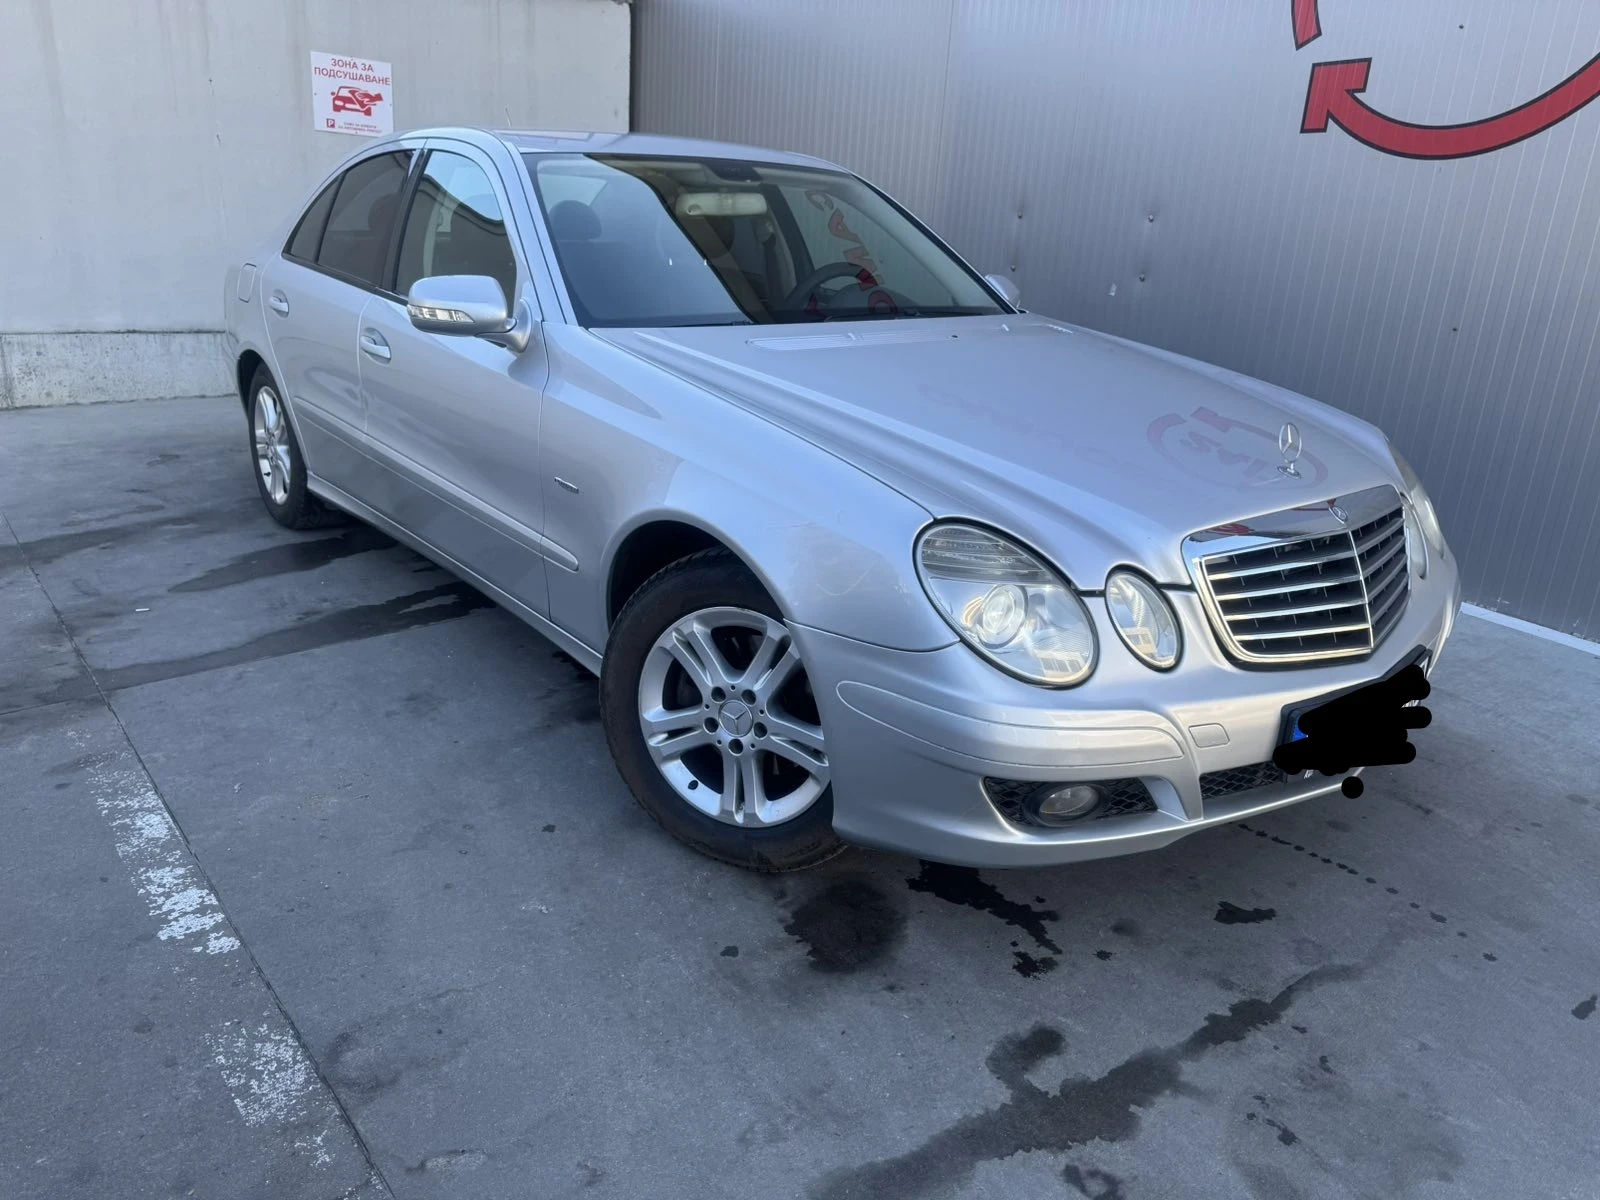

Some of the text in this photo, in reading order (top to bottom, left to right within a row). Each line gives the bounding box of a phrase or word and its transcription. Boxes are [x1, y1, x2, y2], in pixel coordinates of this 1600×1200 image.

[331, 58, 374, 73] ЗОНА ЗА
[314, 66, 391, 86] ПОДСУШАВАНЕ
